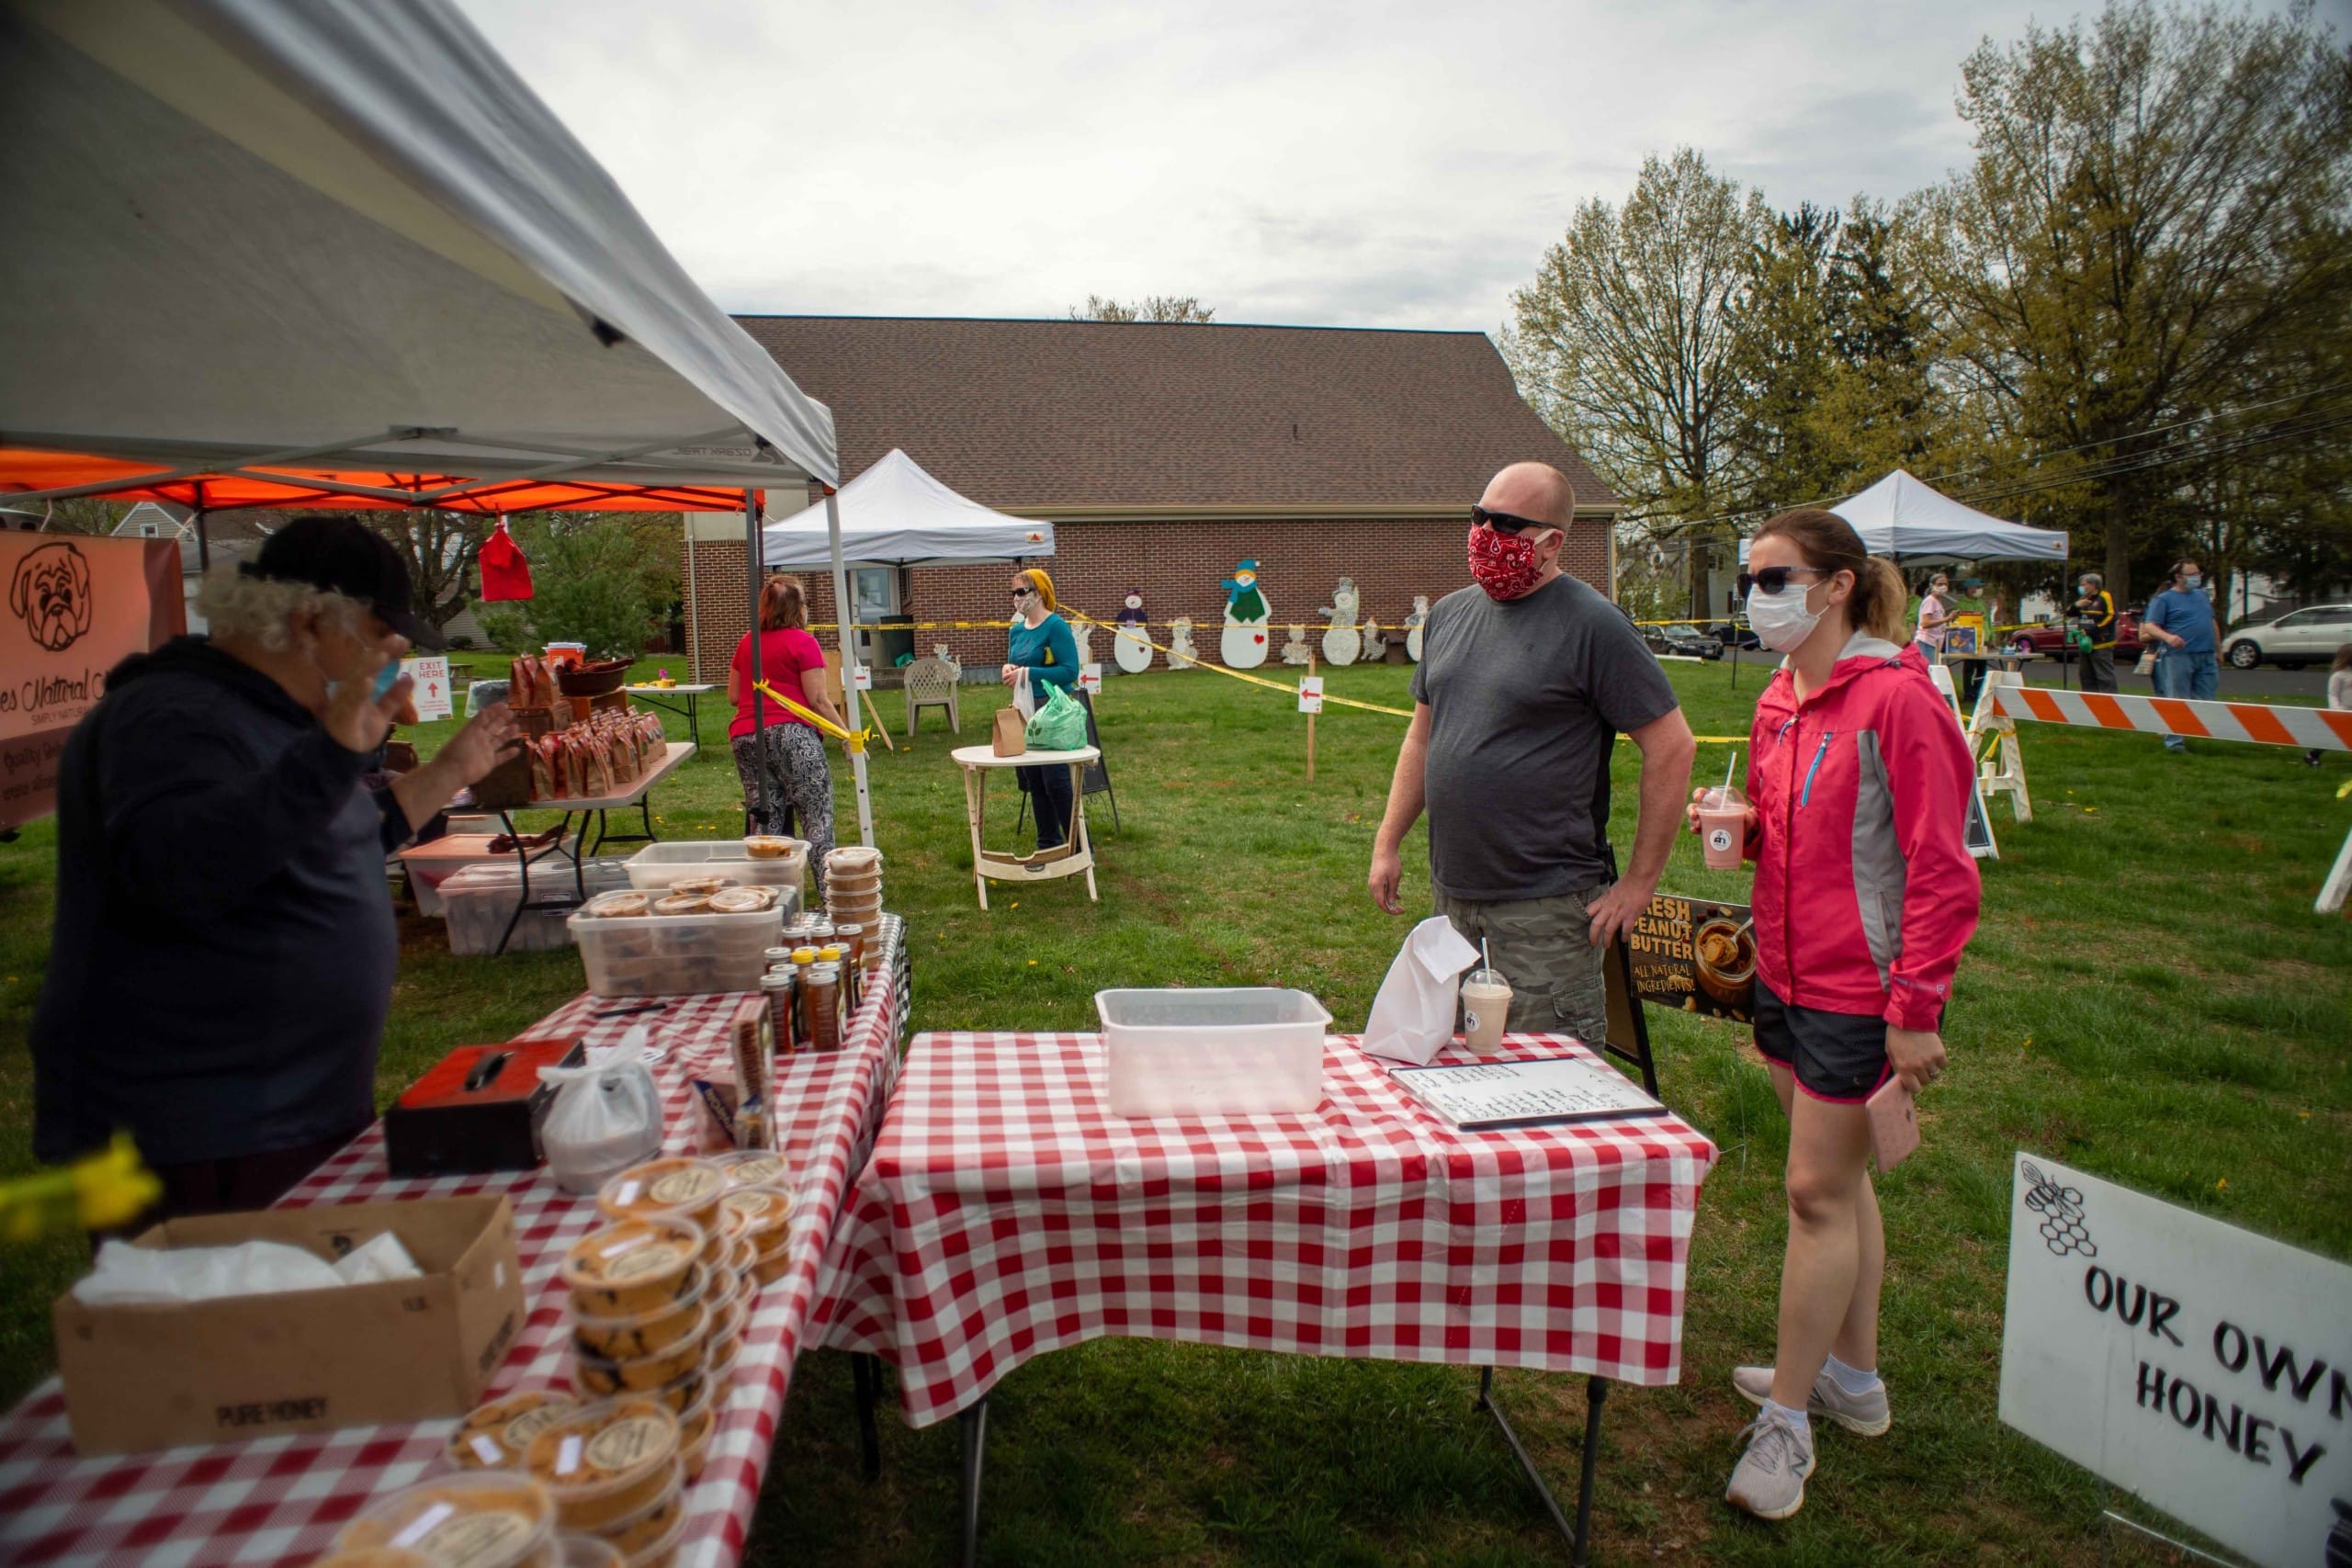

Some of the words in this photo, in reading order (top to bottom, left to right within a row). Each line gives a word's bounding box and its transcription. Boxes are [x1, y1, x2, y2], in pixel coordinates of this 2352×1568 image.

[418, 660, 442, 671] EXIT
[418, 670, 446, 679] HERE
[22, 668, 90, 712] Natural
[1634, 916, 1693, 941] EANUT
[1630, 933, 1694, 961] BUTTER
[1634, 964, 1649, 978] ALL
[1650, 963, 1691, 977] NATURAL
[1636, 977, 1696, 993] INGREDIENTS!
[2084, 1265, 2185, 1348] OUR
[2135, 1359, 2328, 1486] HONEY
